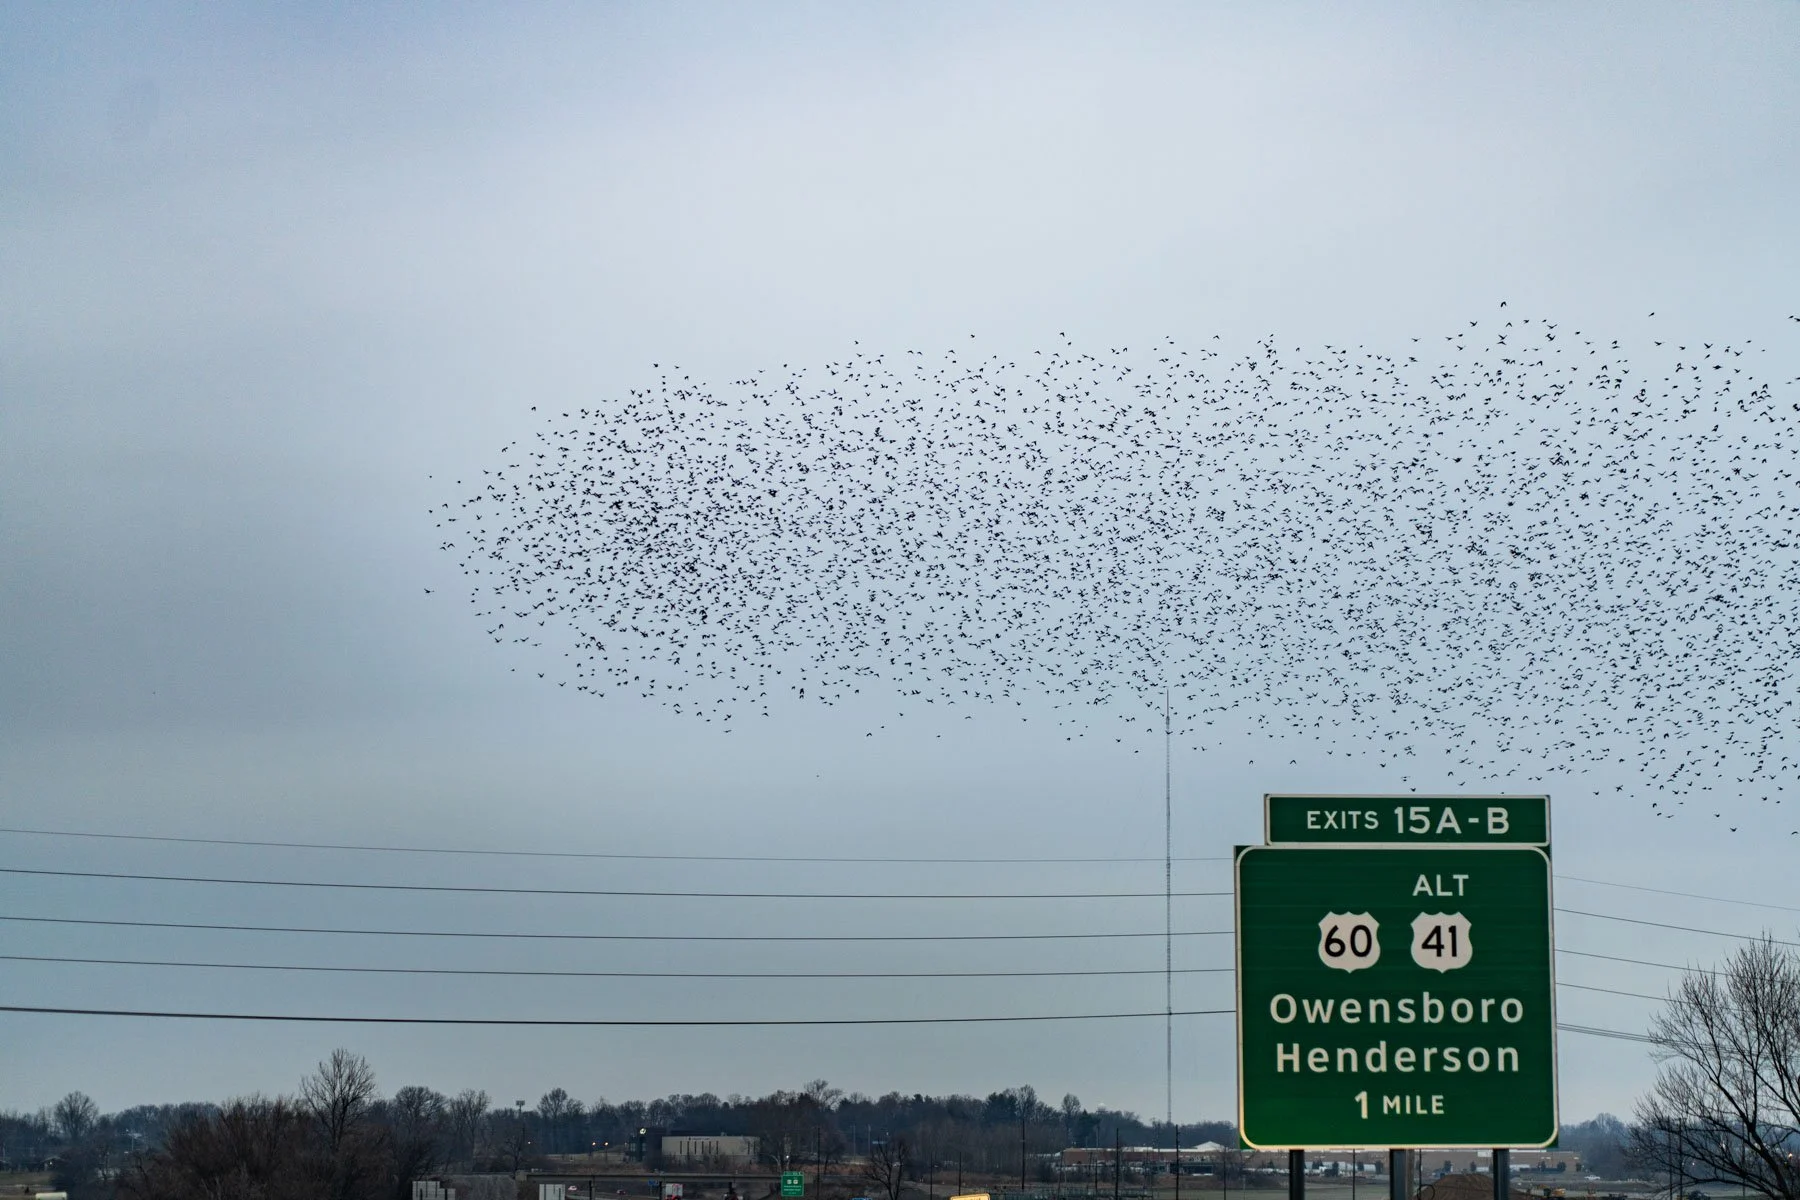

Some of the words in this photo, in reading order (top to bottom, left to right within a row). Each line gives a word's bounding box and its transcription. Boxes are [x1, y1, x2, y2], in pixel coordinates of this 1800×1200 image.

[1307, 810, 1379, 830] EXITS
[1412, 874, 1469, 896] ALT
[1324, 924, 1373, 958] 60
[1421, 925, 1458, 957] 41
[1270, 991, 1524, 1023] Owensboro
[1276, 1040, 1519, 1072] Henderson
[1354, 1091, 1368, 1119] 1
[1383, 1095, 1444, 1114] MILE
